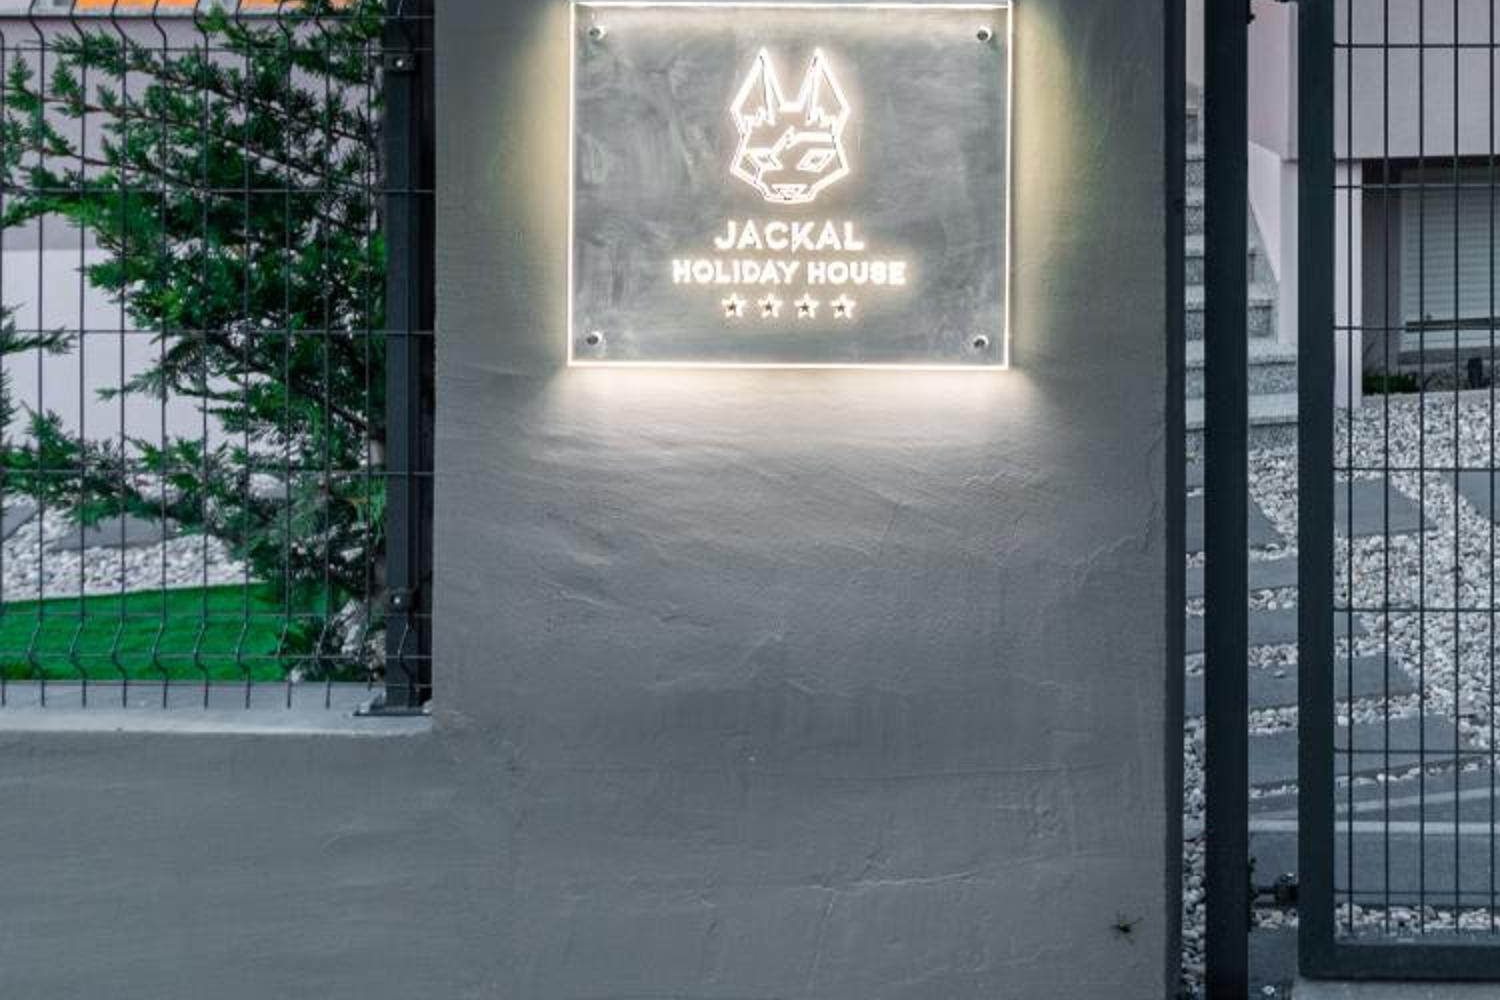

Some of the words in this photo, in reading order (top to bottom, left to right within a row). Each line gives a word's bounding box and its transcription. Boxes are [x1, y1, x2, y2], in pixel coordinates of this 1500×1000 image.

[714, 220, 864, 251] JACKAL
[673, 259, 800, 284] HOLIDAY
[807, 261, 907, 285] HOUSE
